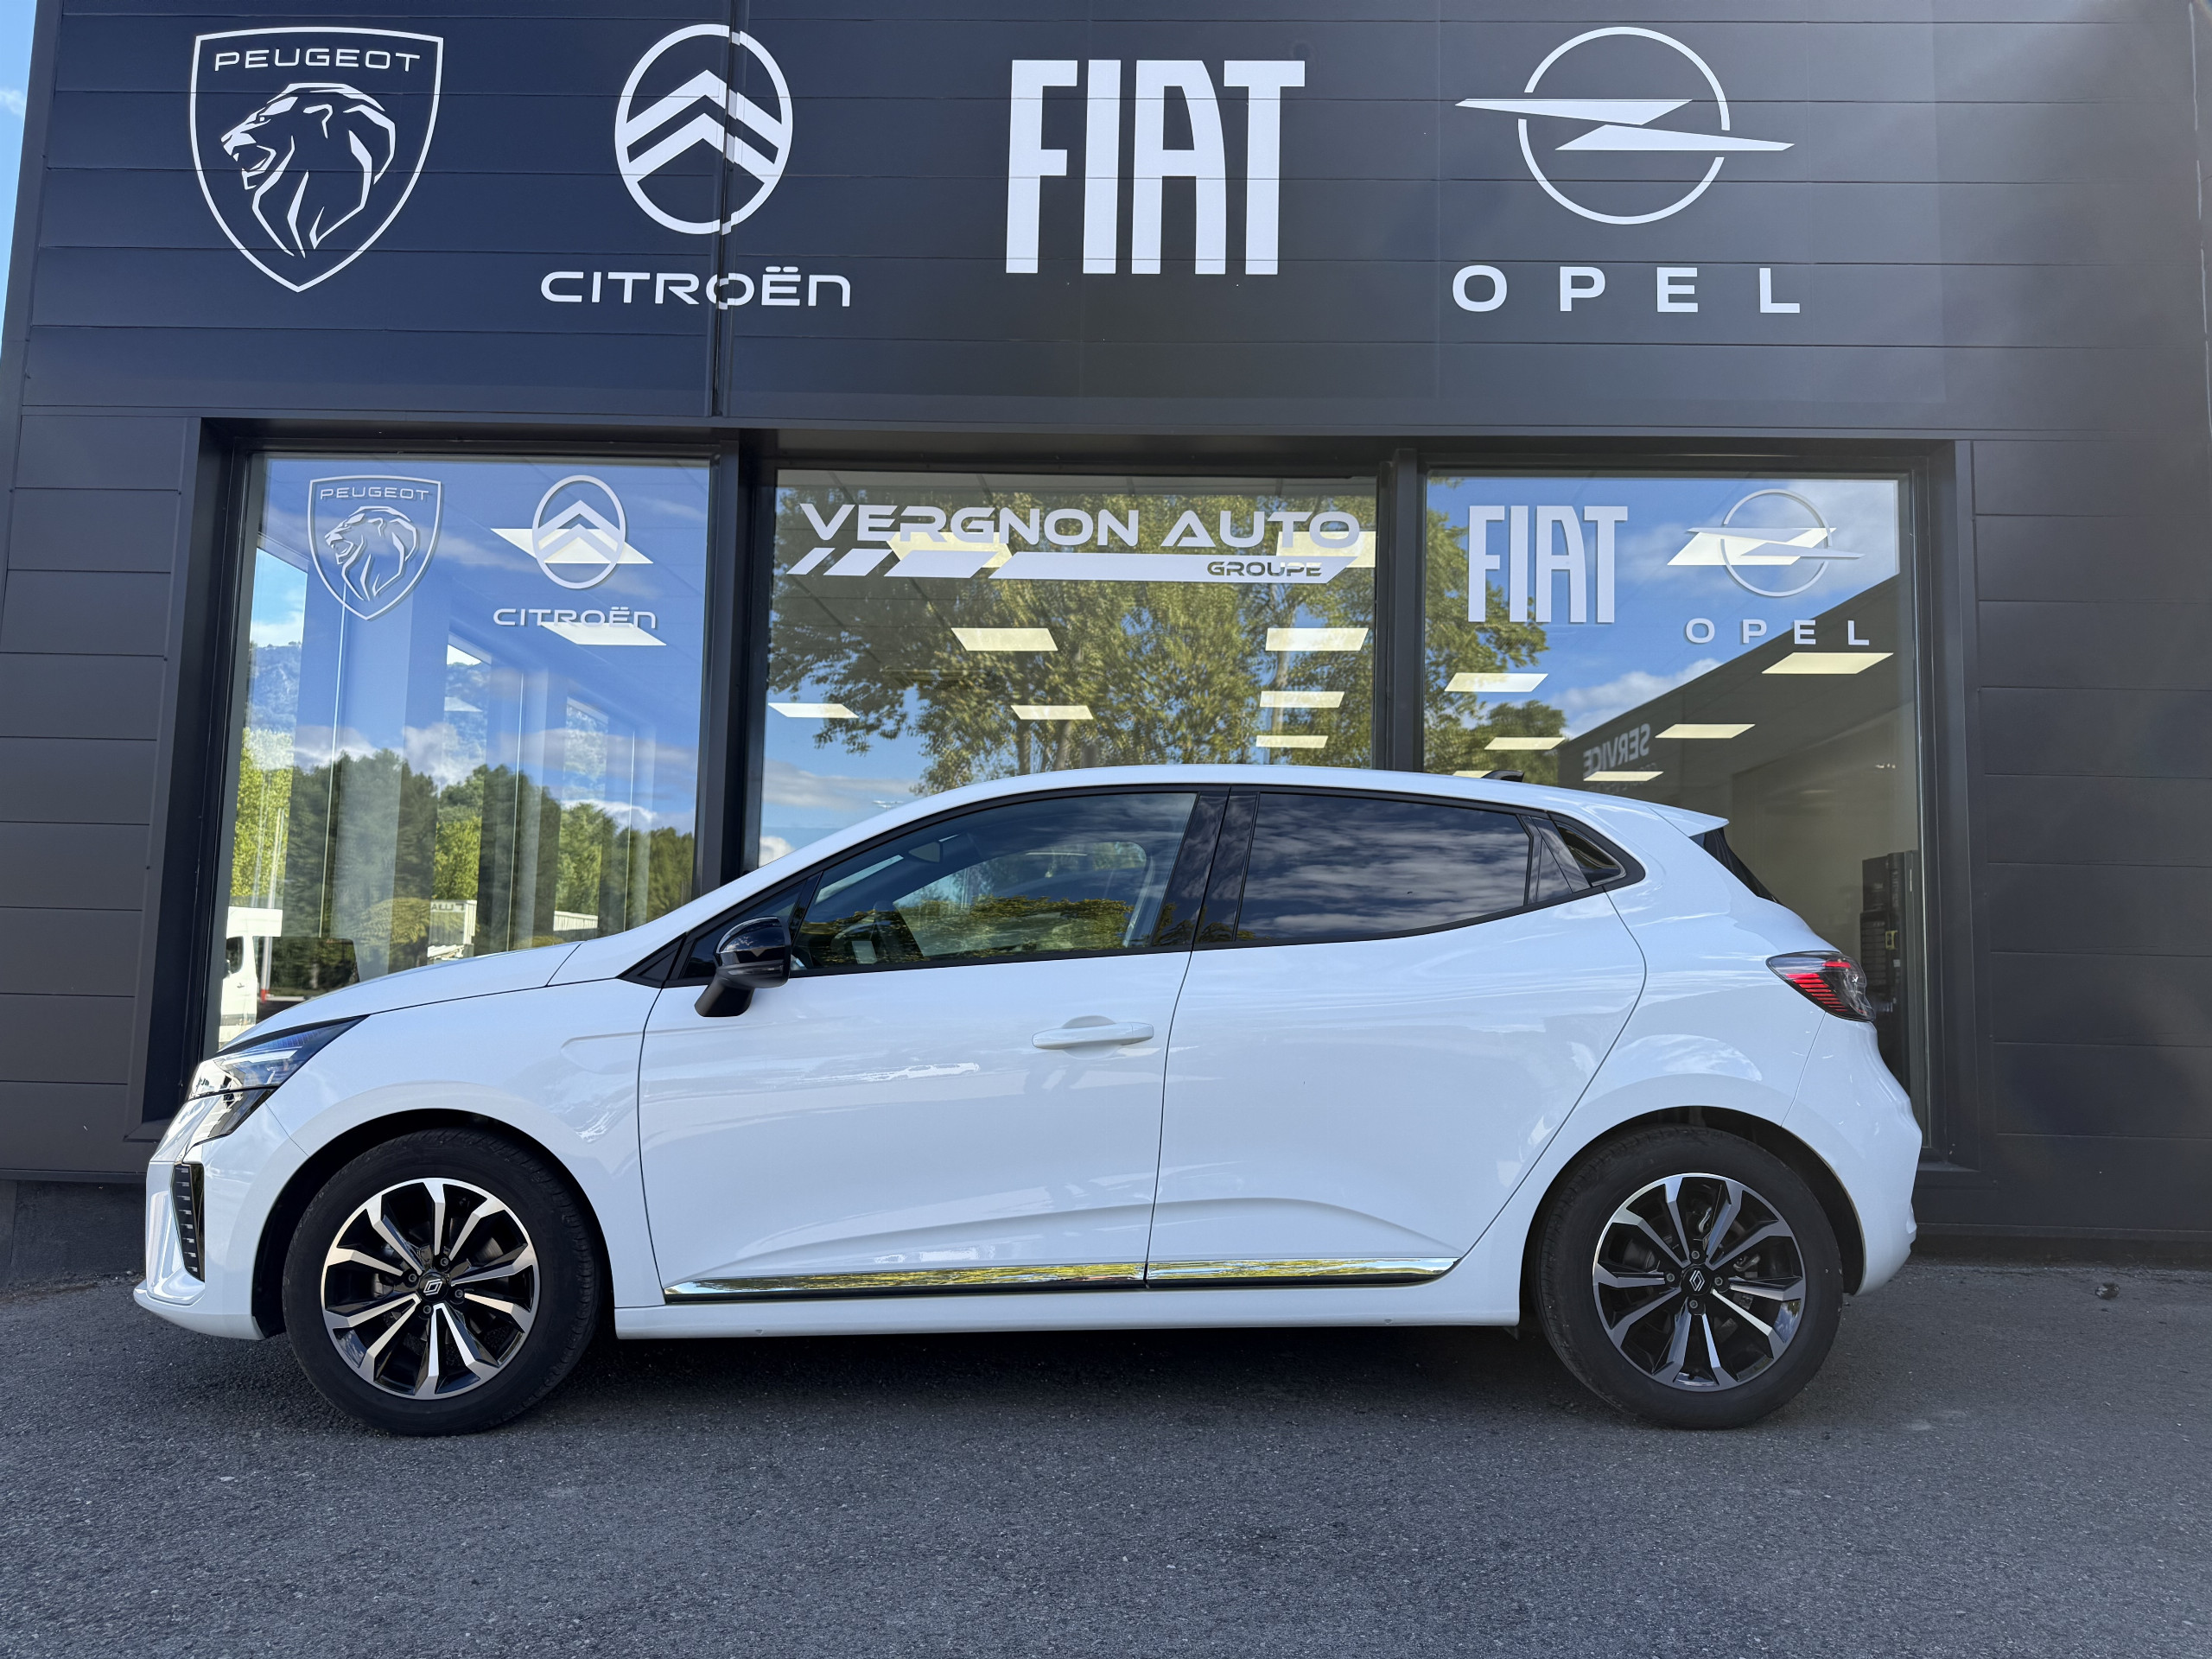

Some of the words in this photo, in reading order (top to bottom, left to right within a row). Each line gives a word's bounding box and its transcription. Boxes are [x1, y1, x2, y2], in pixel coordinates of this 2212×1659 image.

[214, 48, 421, 73] PEUGEOT
[1006, 60, 1306, 275] FIAT
[540, 266, 851, 309] CITROËN
[1452, 264, 1801, 313] OPEL
[320, 486, 429, 500] PEUGEOT
[799, 503, 1141, 547] VERGNON
[1160, 510, 1361, 549] AUTO
[1206, 561, 1322, 577] GROUPE
[1468, 505, 1628, 623] FIAT
[493, 607, 657, 630] CITROËN
[1685, 617, 1870, 646] OPEL
